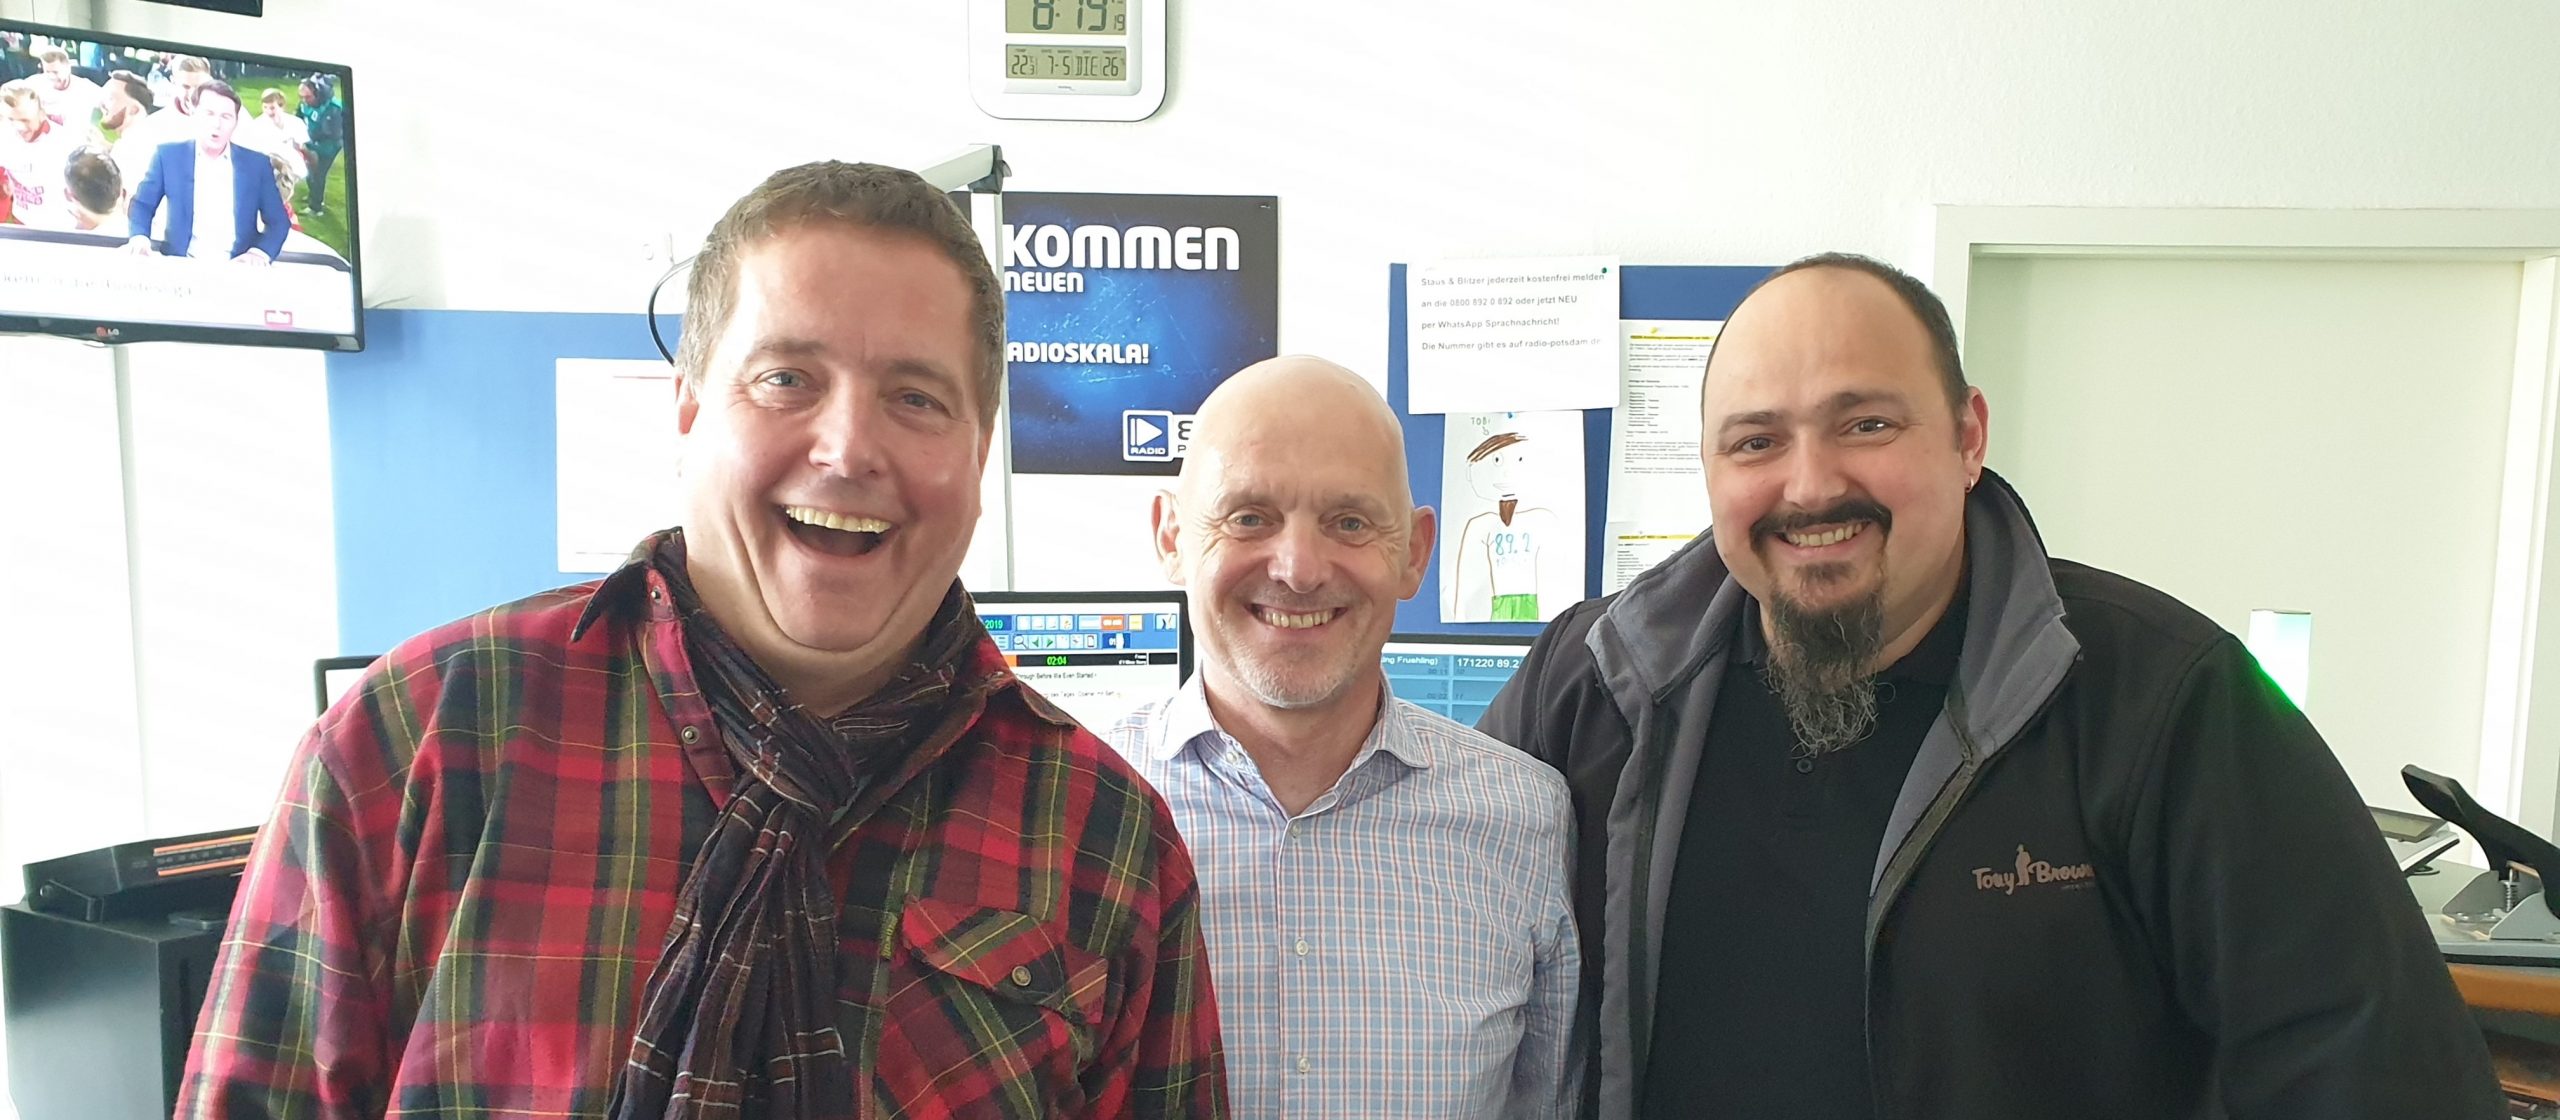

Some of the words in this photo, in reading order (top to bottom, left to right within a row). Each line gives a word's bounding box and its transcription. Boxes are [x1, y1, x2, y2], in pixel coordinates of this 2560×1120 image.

[1002, 224, 1240, 271] KOMMEN
[1004, 271, 1084, 293] NEUEN
[1487, 275, 1525, 286] jederzeit
[1527, 273, 1571, 283] kostenfrei
[1573, 273, 1605, 281] melden
[1421, 300, 1432, 308] an
[1515, 296, 1536, 305] oder
[1537, 295, 1556, 306] jetzt
[1558, 295, 1578, 304] NEU
[1421, 321, 1436, 331] per
[1438, 320, 1483, 329] WhatsApp
[1485, 317, 1560, 328] Sprachnachricht!
[1007, 341, 1149, 364] ADIOSKALA!
[1422, 342, 1436, 351] Die
[1438, 341, 1475, 351] Nummer
[1477, 340, 1494, 352] gibt
[1496, 341, 1507, 349] es
[1509, 340, 1523, 349] auf
[1130, 447, 1166, 455] RADIO
[984, 619, 1004, 630] 2019
[1046, 655, 1067, 666] 02:04
[1457, 657, 1495, 668] 171220
[1972, 867, 2015, 896] Tony
[2028, 860, 2095, 884] Brown
